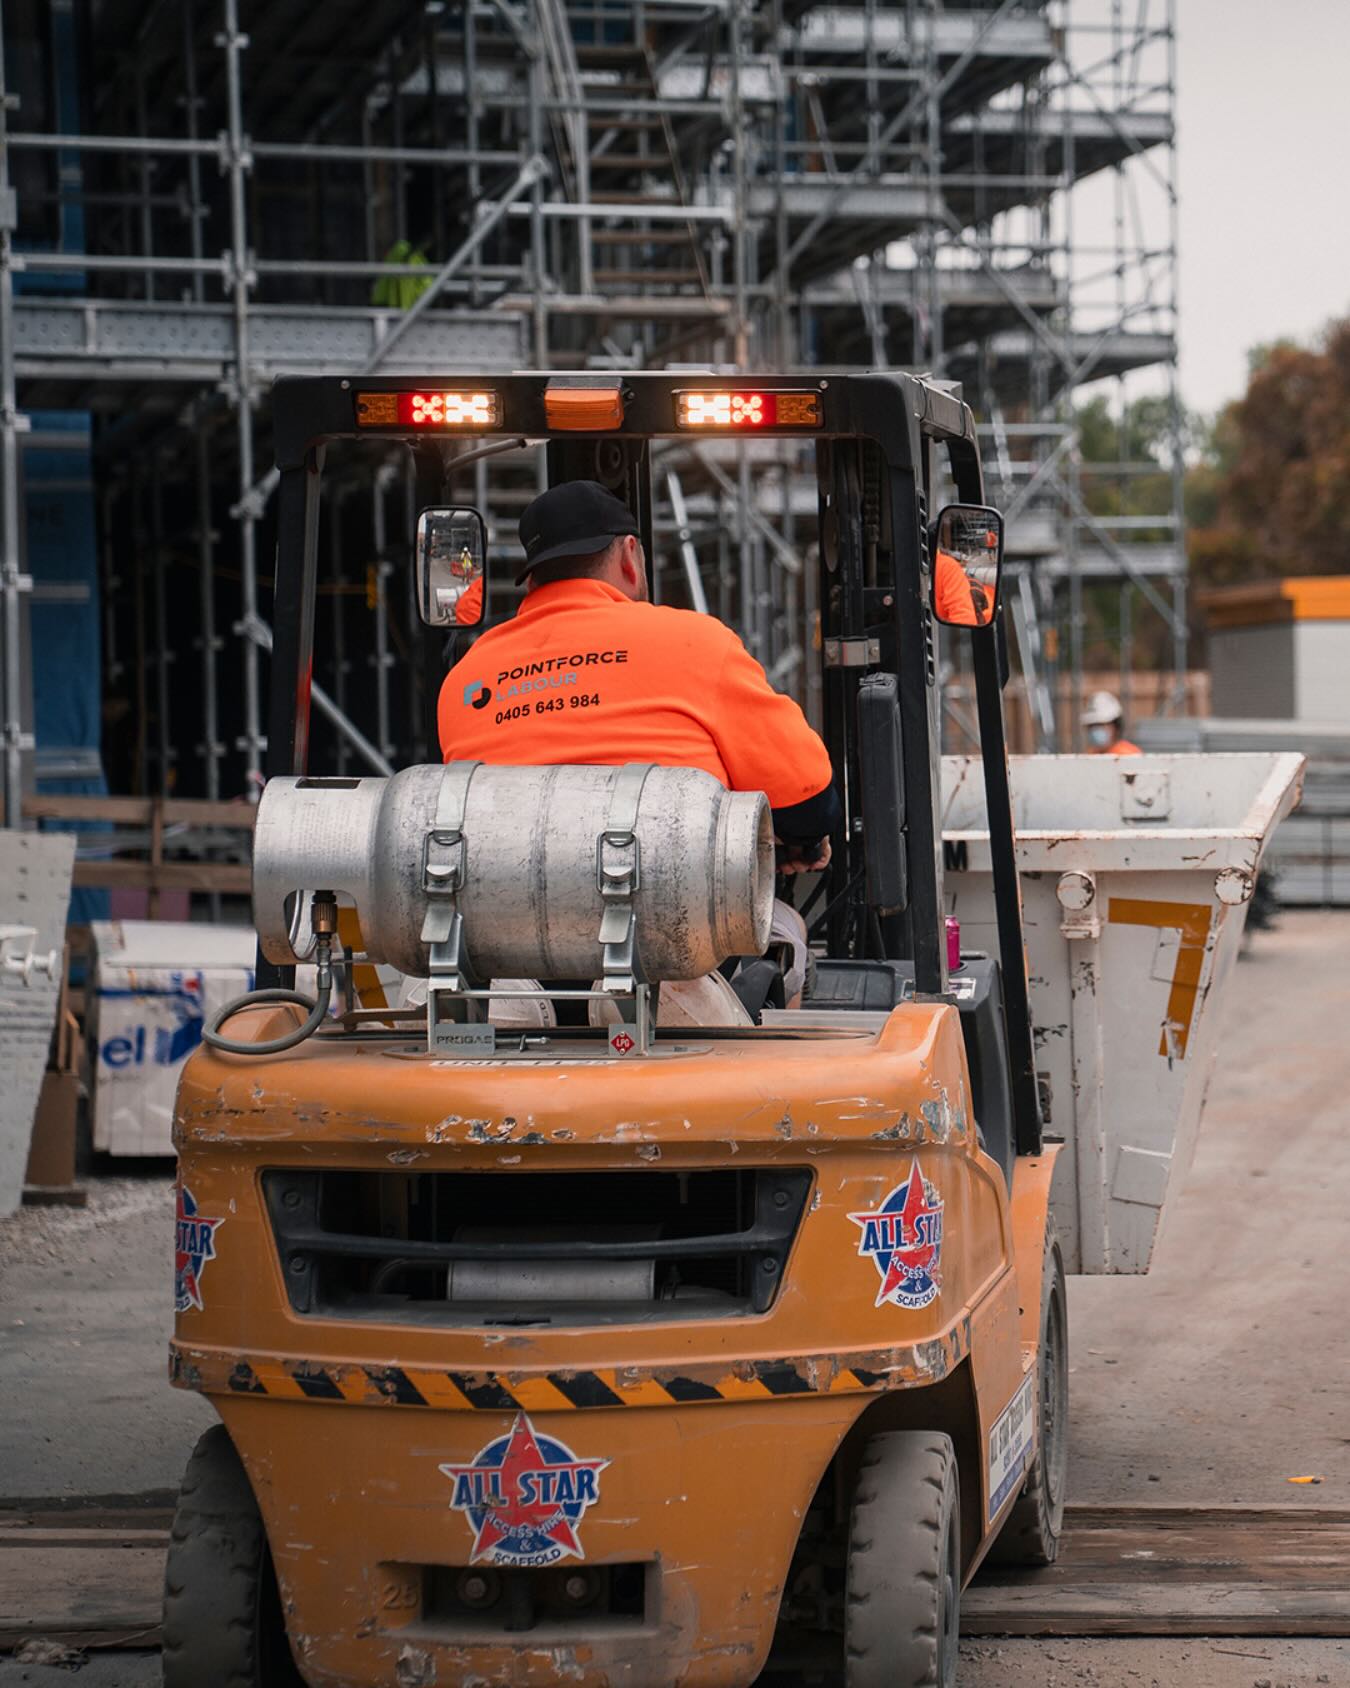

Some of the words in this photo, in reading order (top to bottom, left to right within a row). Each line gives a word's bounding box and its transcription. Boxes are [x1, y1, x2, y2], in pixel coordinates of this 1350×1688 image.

[497, 650, 628, 685] POINTFORCE
[496, 672, 577, 702] LABOUR
[495, 704, 531, 724] 0405
[535, 697, 565, 714] 643
[570, 693, 600, 708] 984
[863, 1218, 907, 1251] ALL
[891, 1256, 924, 1279] ACCESS
[454, 1473, 508, 1506] ALL
[518, 1468, 597, 1505] STAR
[486, 1510, 534, 1538] ACCESS
[494, 1548, 561, 1565] SCAFFOLD
